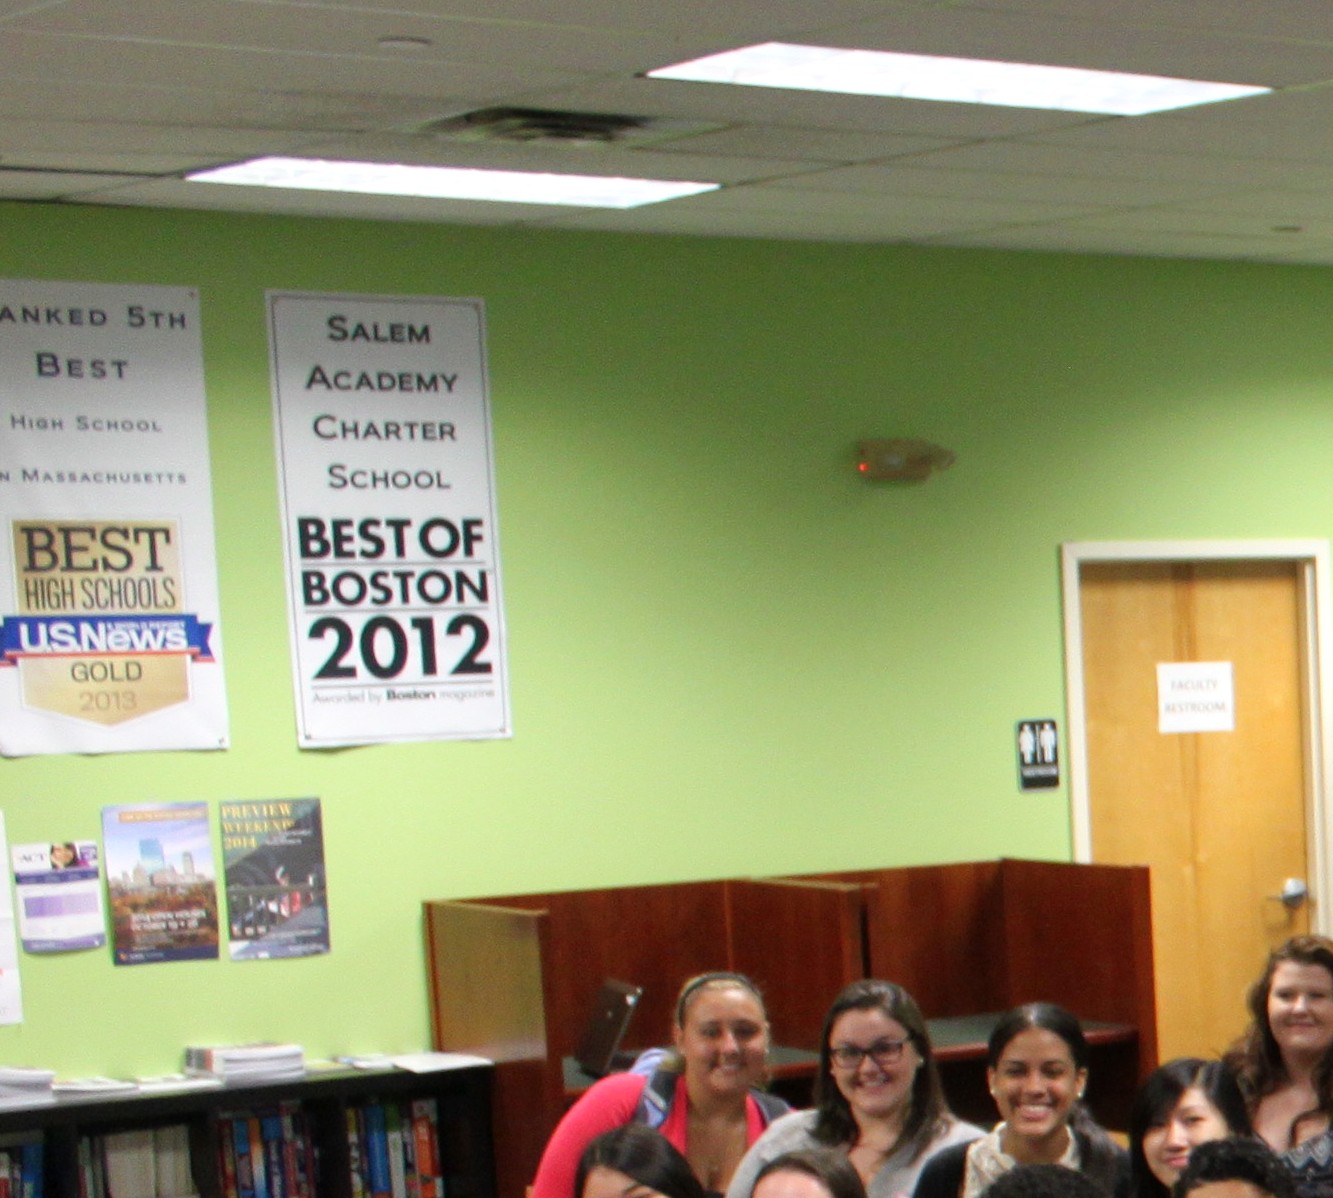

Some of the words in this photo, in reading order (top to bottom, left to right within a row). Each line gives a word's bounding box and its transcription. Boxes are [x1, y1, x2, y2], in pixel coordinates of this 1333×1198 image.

[127, 306, 186, 329] 5TH
[327, 315, 431, 343] SALEM
[36, 352, 129, 379] BEST
[305, 365, 457, 393] ACADEMY
[76, 415, 163, 433] SCHOOL
[313, 414, 456, 441] CHARTER
[22, 468, 187, 484] MASSACHUSETTS
[328, 463, 451, 490] SCHOOL
[20, 526, 171, 572] BEST
[298, 517, 412, 560] BEST
[419, 517, 483, 558] OF
[25, 578, 76, 610] HIGH
[81, 577, 176, 609] SCHOOLS
[301, 570, 489, 606] BOSTON
[308, 614, 492, 680] 2012
[71, 661, 142, 682] GOLD
[1170, 679, 1218, 691] FACULTY
[79, 692, 136, 711] 2013
[313, 690, 365, 703] Awarded
[368, 689, 382, 706] by
[386, 689, 436, 701] Boston
[439, 689, 495, 704] magazine
[1164, 701, 1226, 714] RESTROOM
[222, 803, 292, 819] PREVIEW
